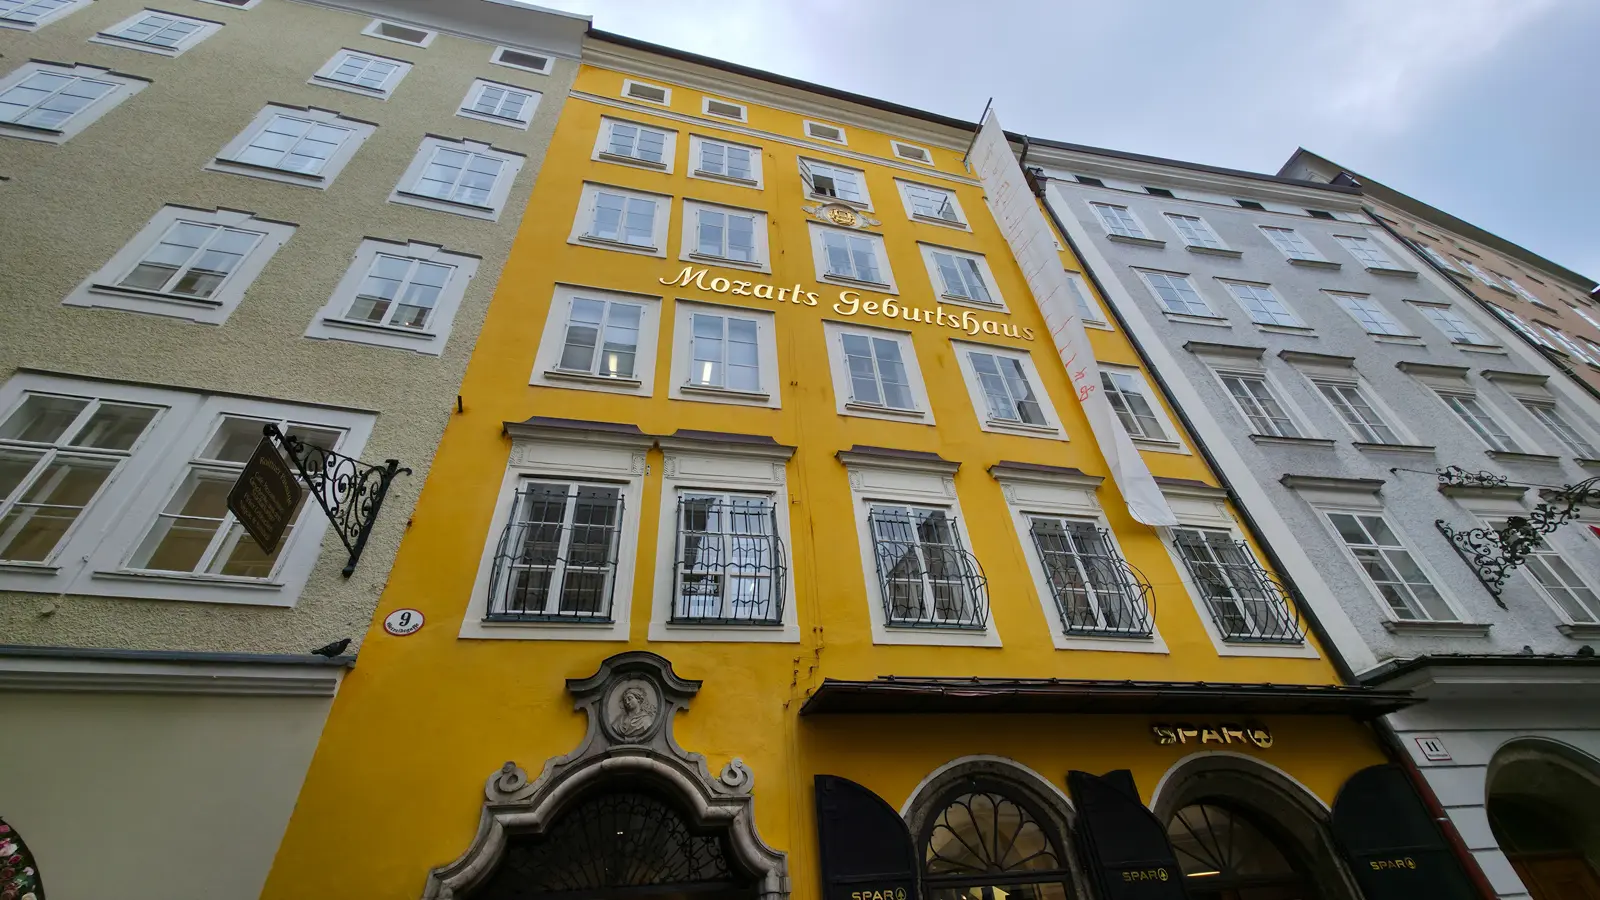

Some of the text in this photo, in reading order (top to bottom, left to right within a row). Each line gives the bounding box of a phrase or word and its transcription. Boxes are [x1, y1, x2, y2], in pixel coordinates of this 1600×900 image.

[659, 266, 1035, 342] Mozarts Geburtshaus
[399, 611, 411, 627] 9
[1152, 723, 1248, 744] SPAR
[1425, 740, 1440, 752] 11
[1369, 859, 1407, 871] SPAR
[1121, 870, 1159, 882] SPAR
[851, 889, 894, 900] SPAR
